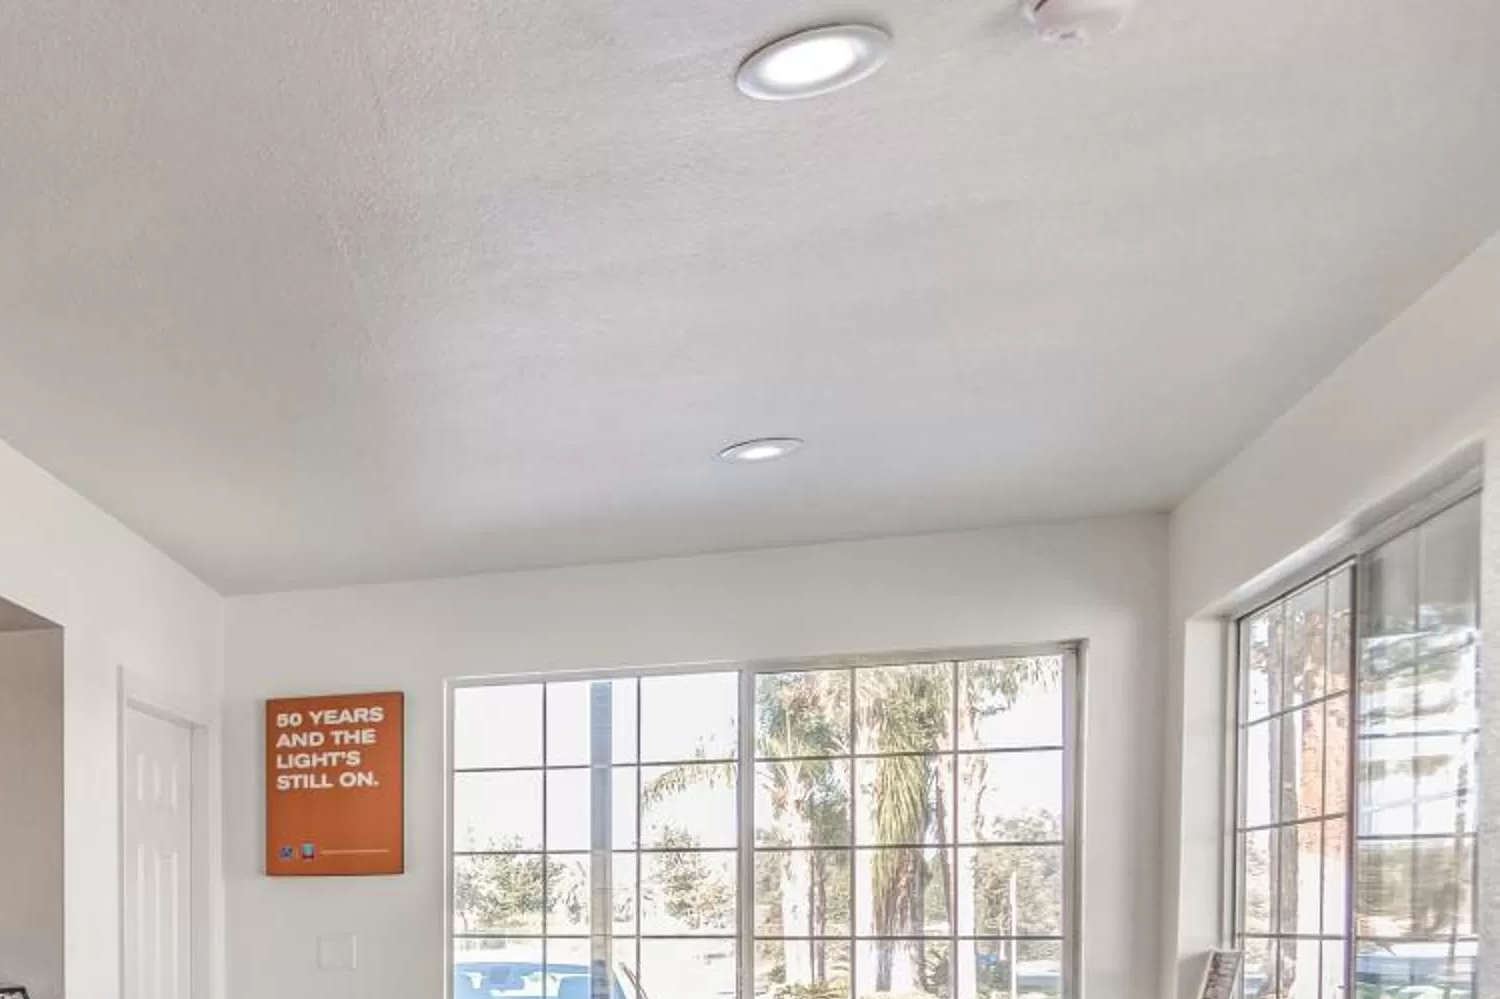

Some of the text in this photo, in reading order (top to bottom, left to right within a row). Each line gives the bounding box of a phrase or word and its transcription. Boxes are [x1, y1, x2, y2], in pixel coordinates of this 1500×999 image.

[276, 706, 384, 728] 50 YEARS
[276, 728, 377, 748] AND THE
[276, 751, 361, 769] LIGHT'S
[276, 770, 380, 791] STILL ON.
